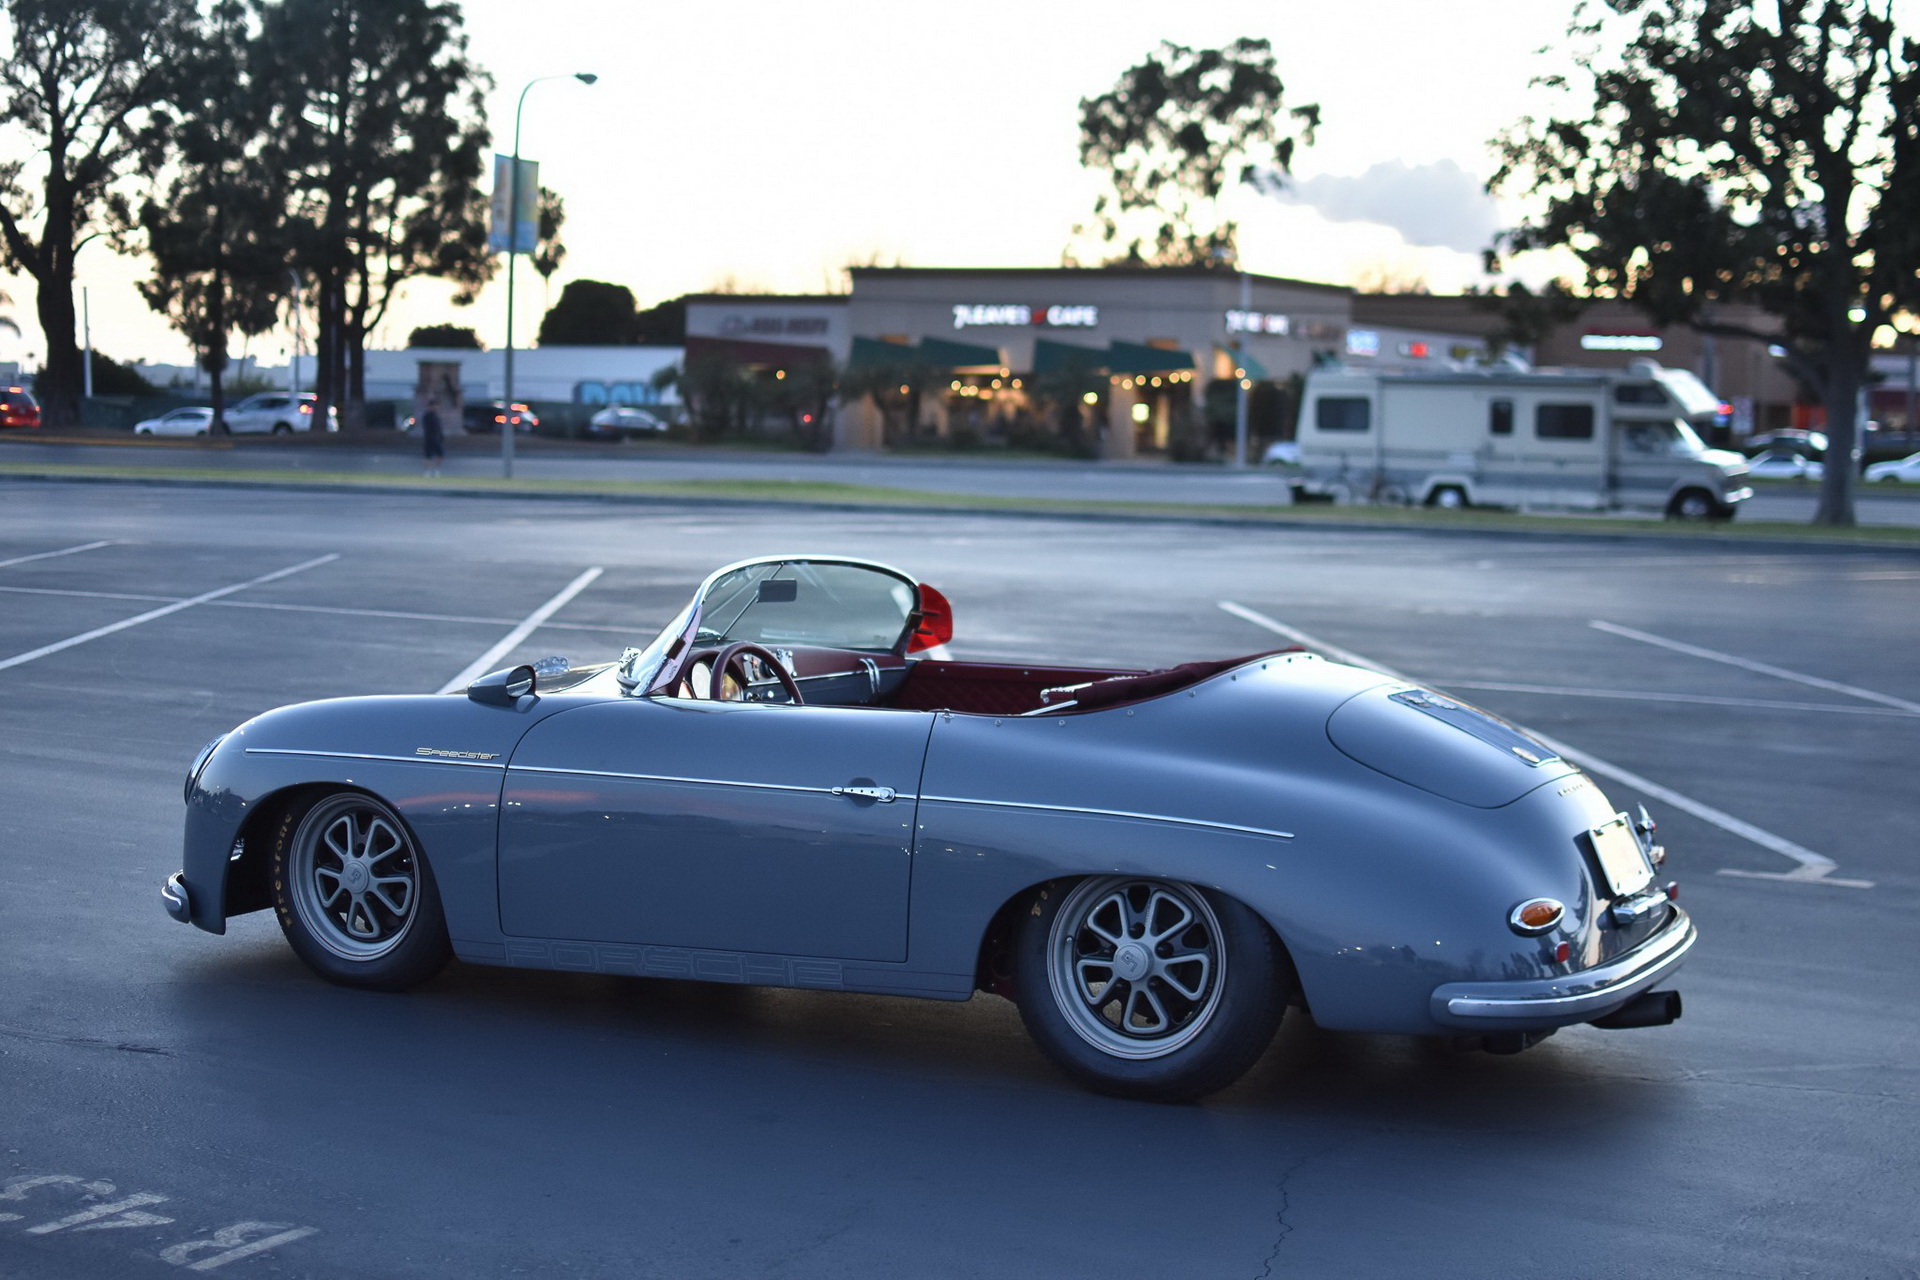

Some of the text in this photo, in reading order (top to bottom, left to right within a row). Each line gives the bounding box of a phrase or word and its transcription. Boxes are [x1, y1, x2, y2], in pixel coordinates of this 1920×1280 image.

[1047, 305, 1099, 326] CAFE
[415, 747, 501, 760] Speedster
[503, 938, 844, 990] PORSCHE
